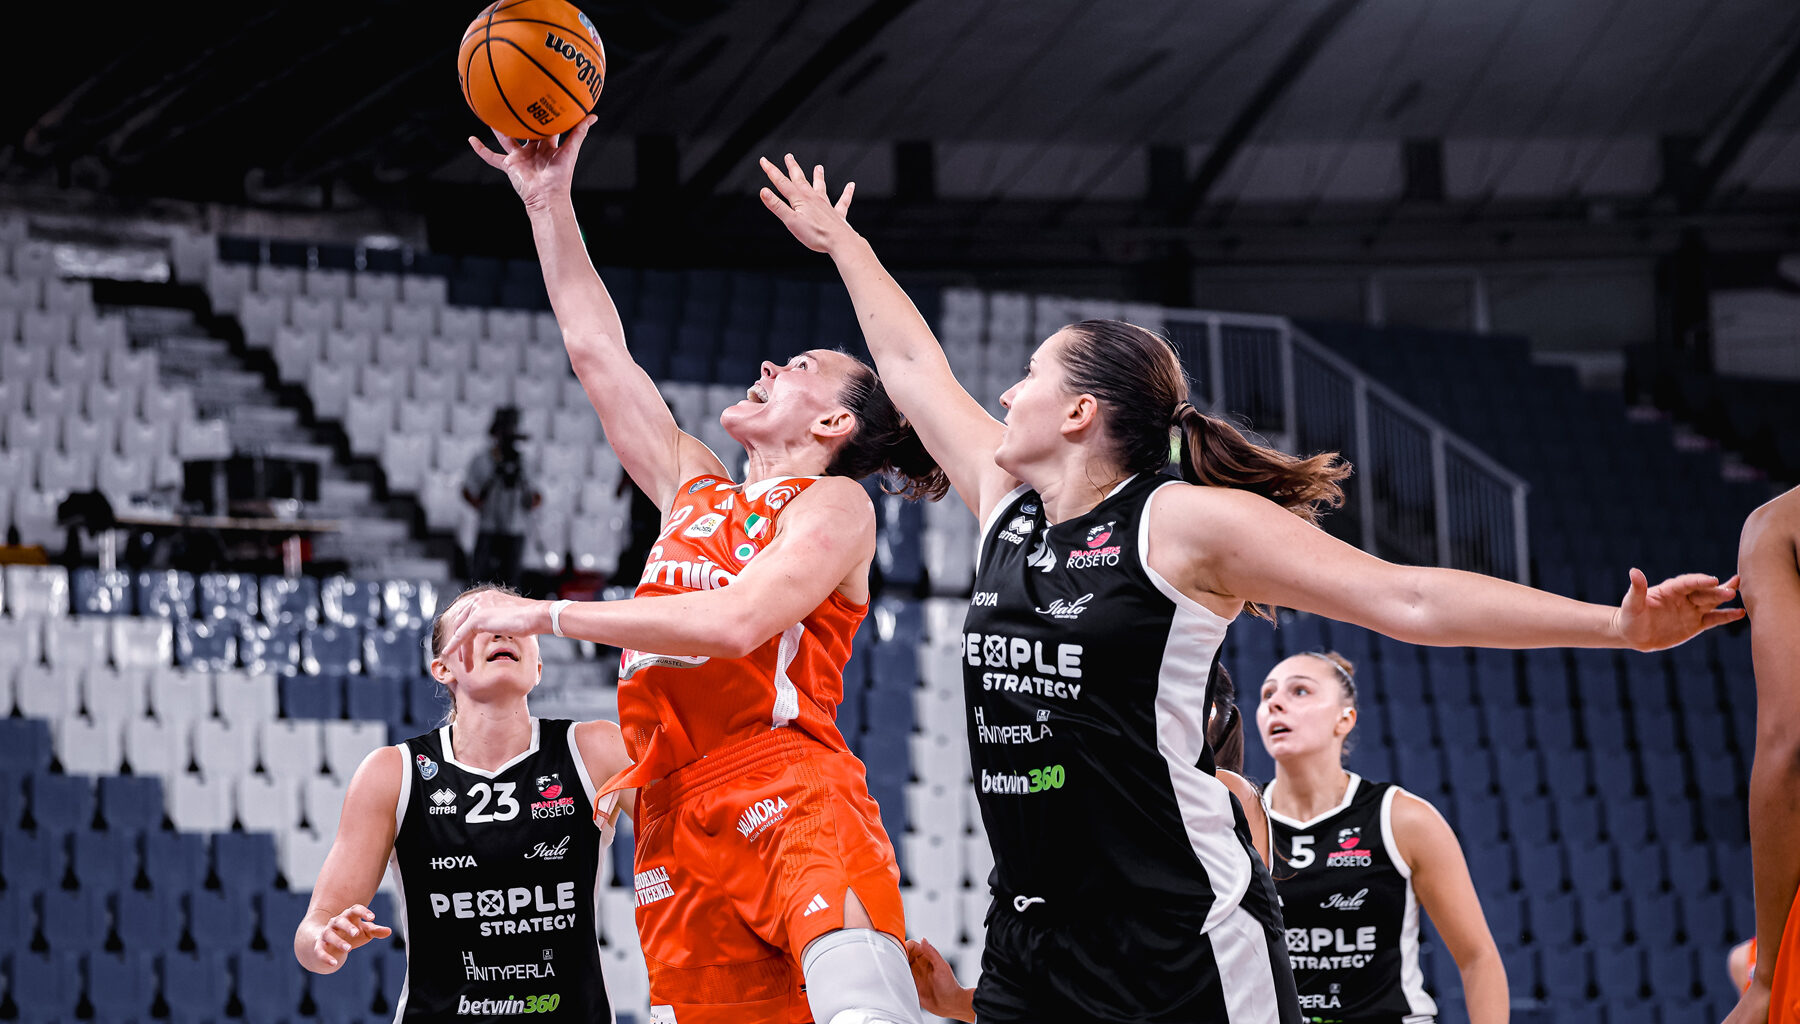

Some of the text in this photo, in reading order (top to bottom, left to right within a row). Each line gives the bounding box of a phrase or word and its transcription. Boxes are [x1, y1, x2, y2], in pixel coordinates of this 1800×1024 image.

[545, 32, 603, 103] Wilson
[527, 102, 554, 126] FIBA
[1066, 553, 1120, 569] ROSETO
[1070, 546, 1121, 559] PANTHERS
[1035, 593, 1094, 615] Italo
[982, 672, 1081, 700] STRATEGY
[465, 782, 520, 824] 23
[531, 804, 575, 820] ROSETO
[524, 835, 570, 859] Italo
[1288, 835, 1316, 869] 5
[429, 855, 478, 870] HOYA
[430, 881, 576, 919] PEOPLE
[480, 913, 576, 937] STRATEGY
[1284, 926, 1377, 953] OPLE
[457, 993, 561, 1016] betwin360
